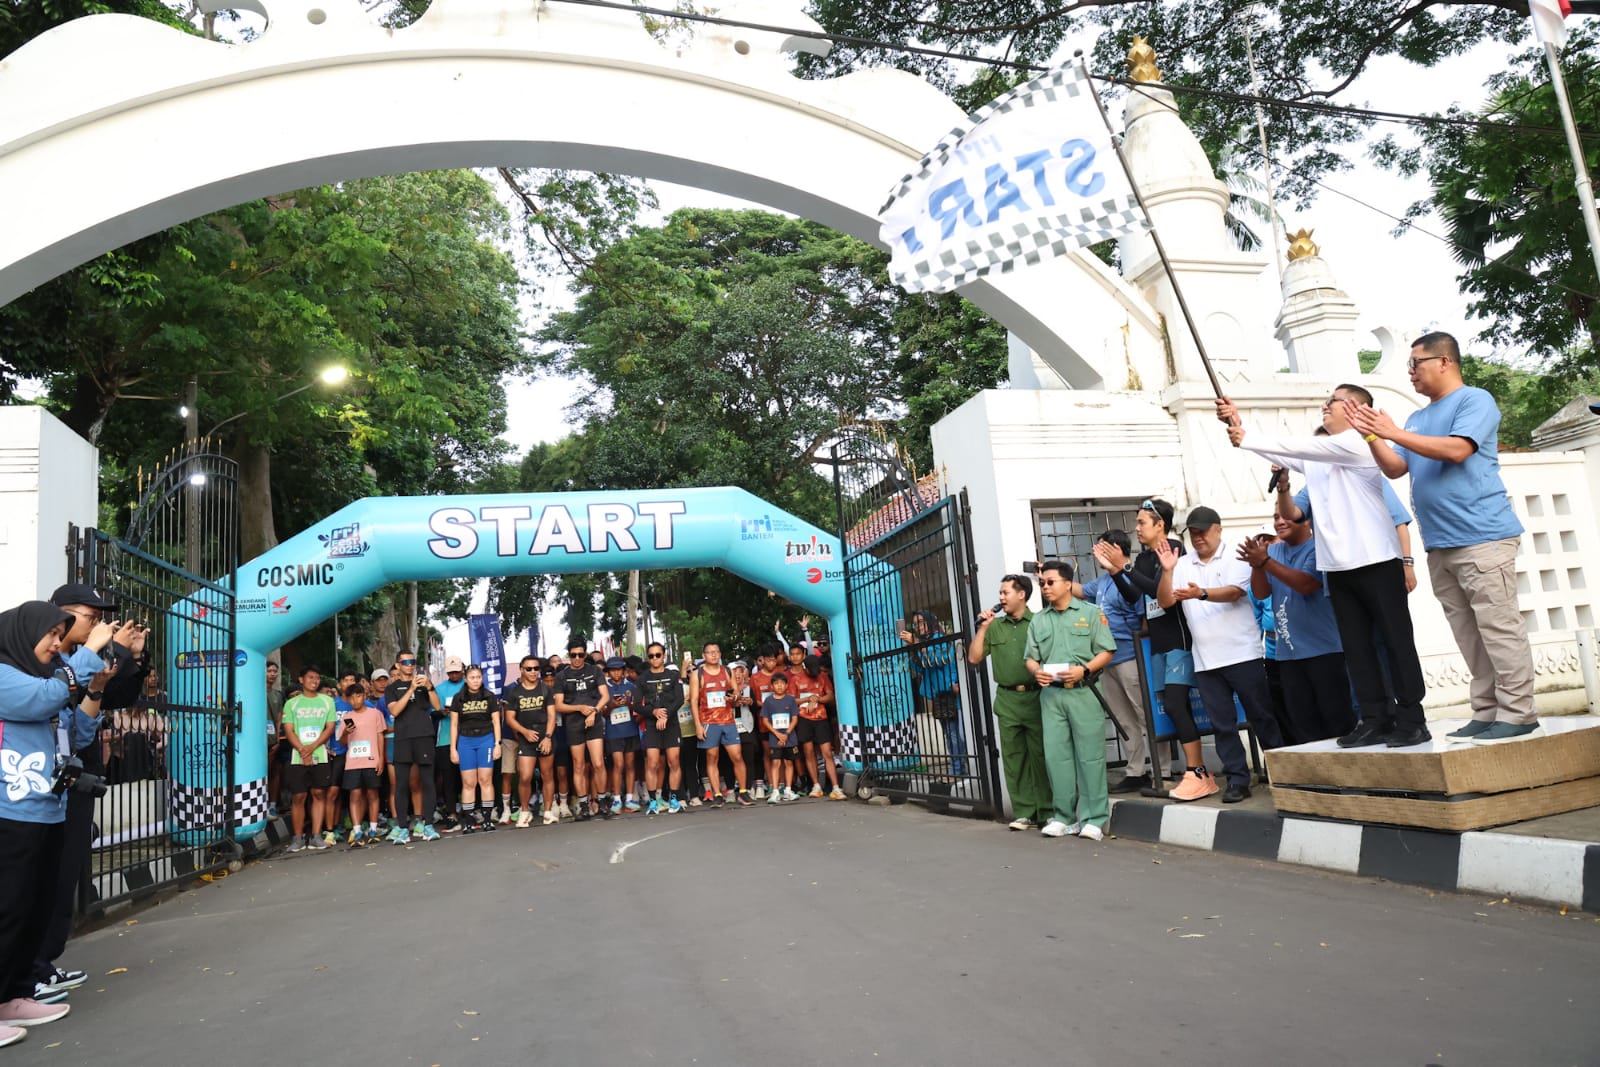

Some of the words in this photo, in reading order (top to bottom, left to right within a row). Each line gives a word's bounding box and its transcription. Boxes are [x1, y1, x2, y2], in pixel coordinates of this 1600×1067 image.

[427, 500, 687, 559] START
[741, 532, 774, 540] BANTEN
[331, 544, 362, 554] 2025
[257, 563, 334, 588] COSMIC
